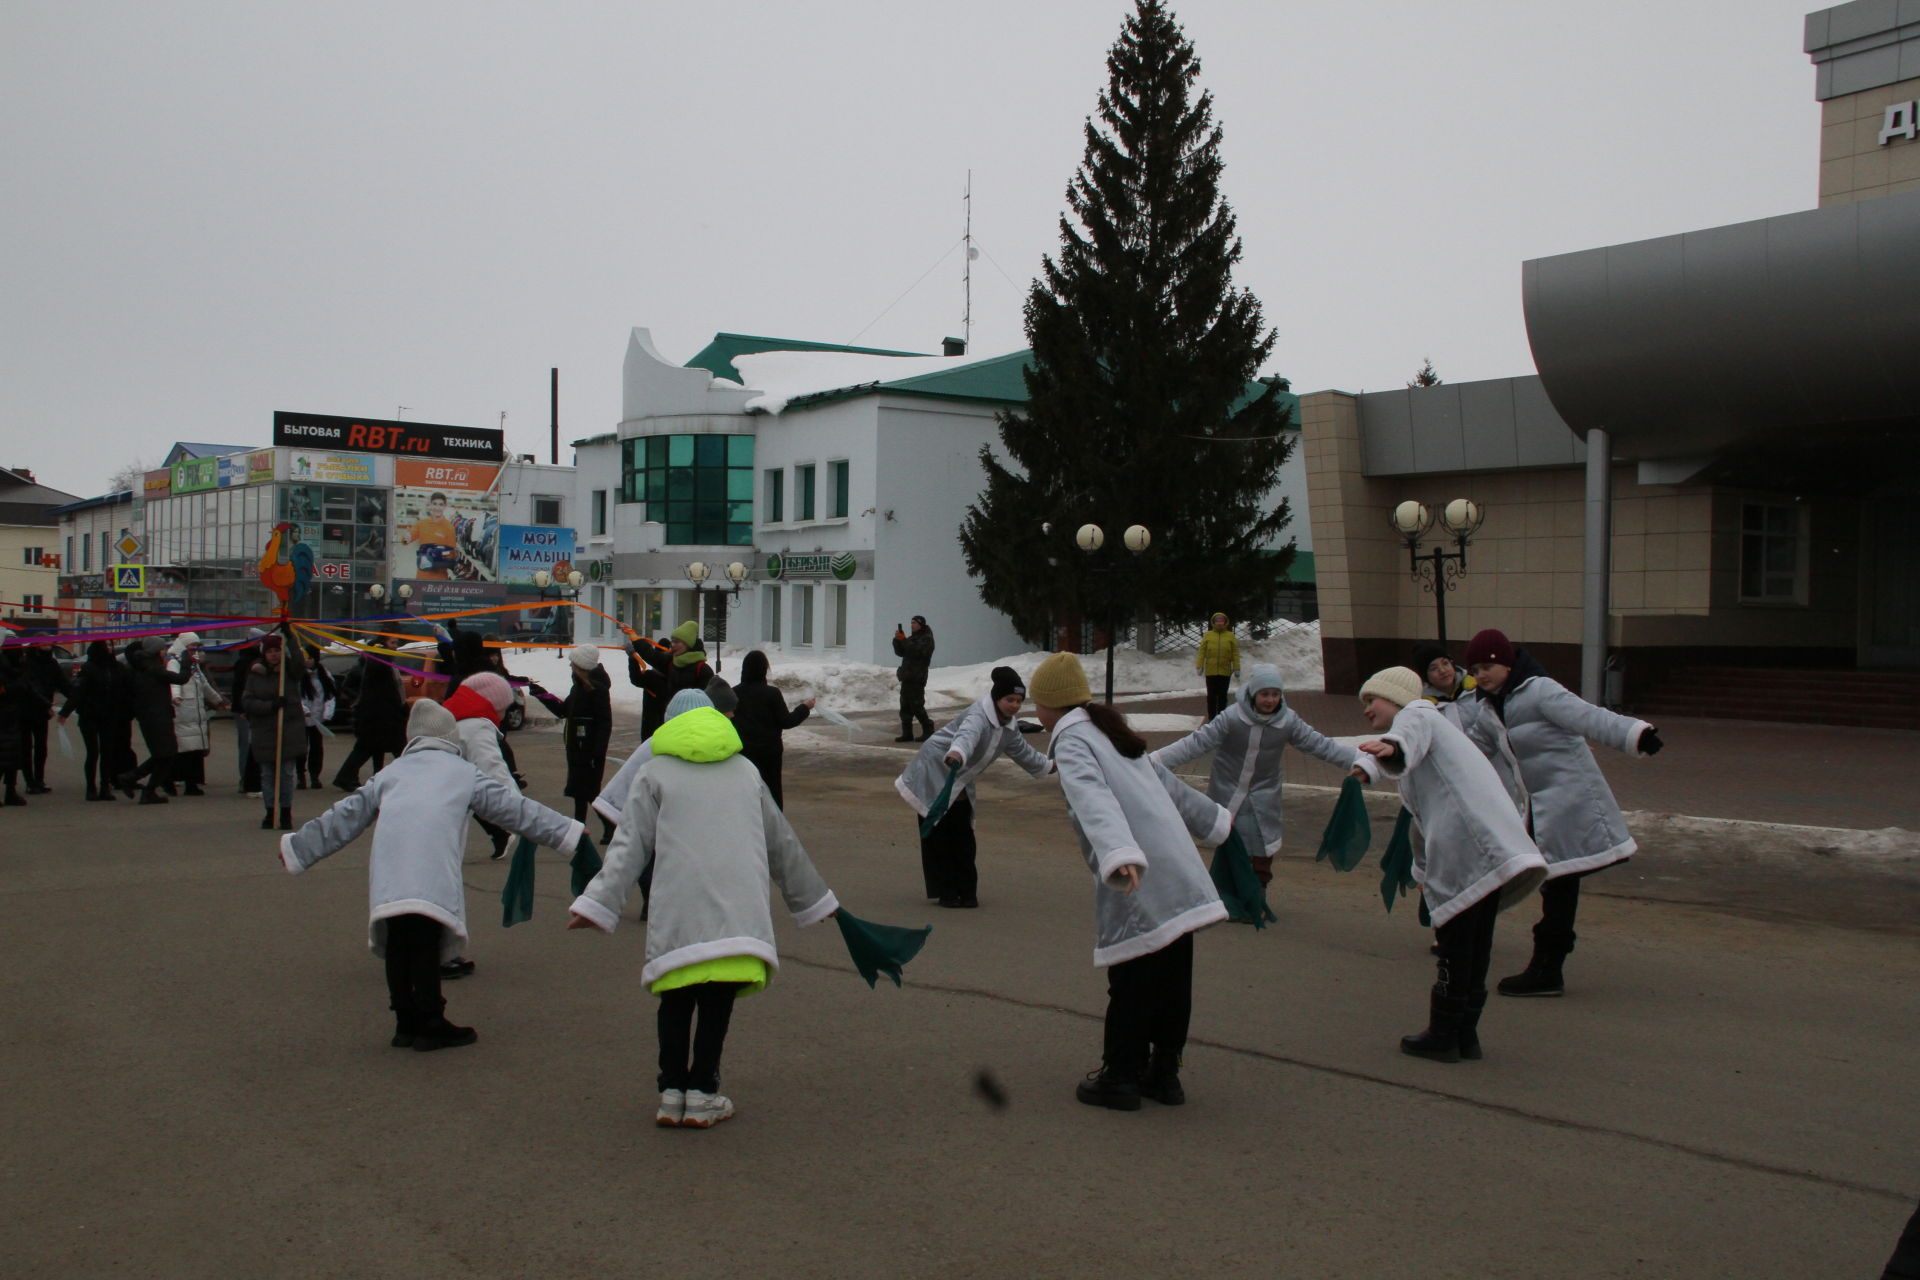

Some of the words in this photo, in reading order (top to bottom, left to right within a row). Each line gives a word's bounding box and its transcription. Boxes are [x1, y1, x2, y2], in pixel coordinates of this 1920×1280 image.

[1878, 99, 1920, 146] Д
[284, 424, 341, 438] БЫТОВАЯ
[347, 424, 432, 453] RBT.ru
[443, 437, 493, 450] ТЕХНИКА
[317, 463, 368, 472] РЫБАЛКИ
[425, 467, 467, 481] RBT.ru
[326, 472, 370, 481] ОТДЫХА
[523, 531, 558, 545] МОЙ
[509, 549, 571, 563] МАЛЫШ
[312, 562, 351, 579] АФЕ
[444, 585, 459, 593] для
